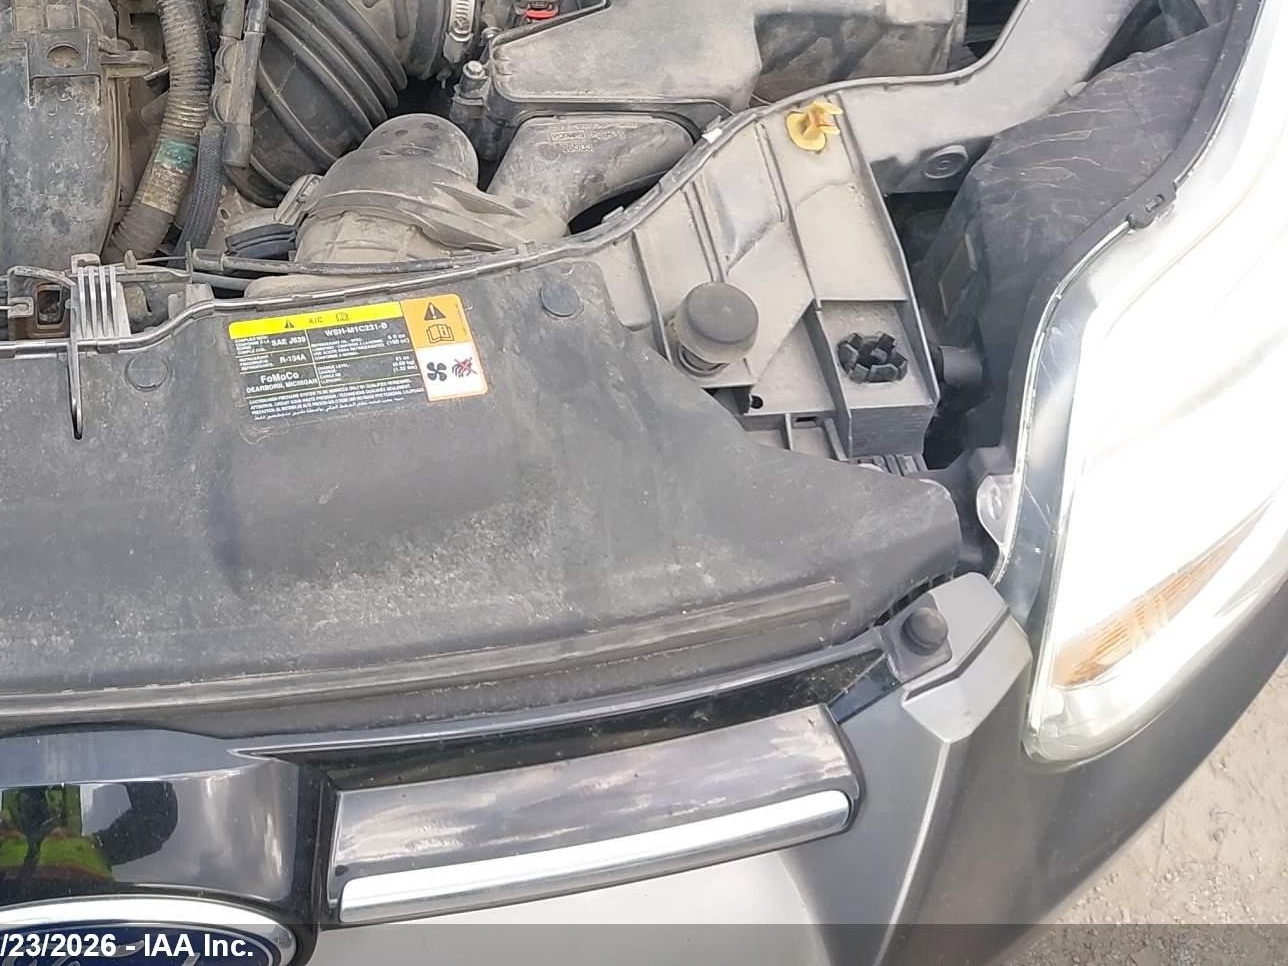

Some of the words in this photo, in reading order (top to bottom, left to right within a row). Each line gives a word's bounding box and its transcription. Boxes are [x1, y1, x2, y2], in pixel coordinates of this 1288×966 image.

[308, 316, 324, 325] A/C
[271, 338, 288, 347] SAE
[260, 371, 300, 384] FoMoCo
[285, 377, 318, 388] MICHIGAN
